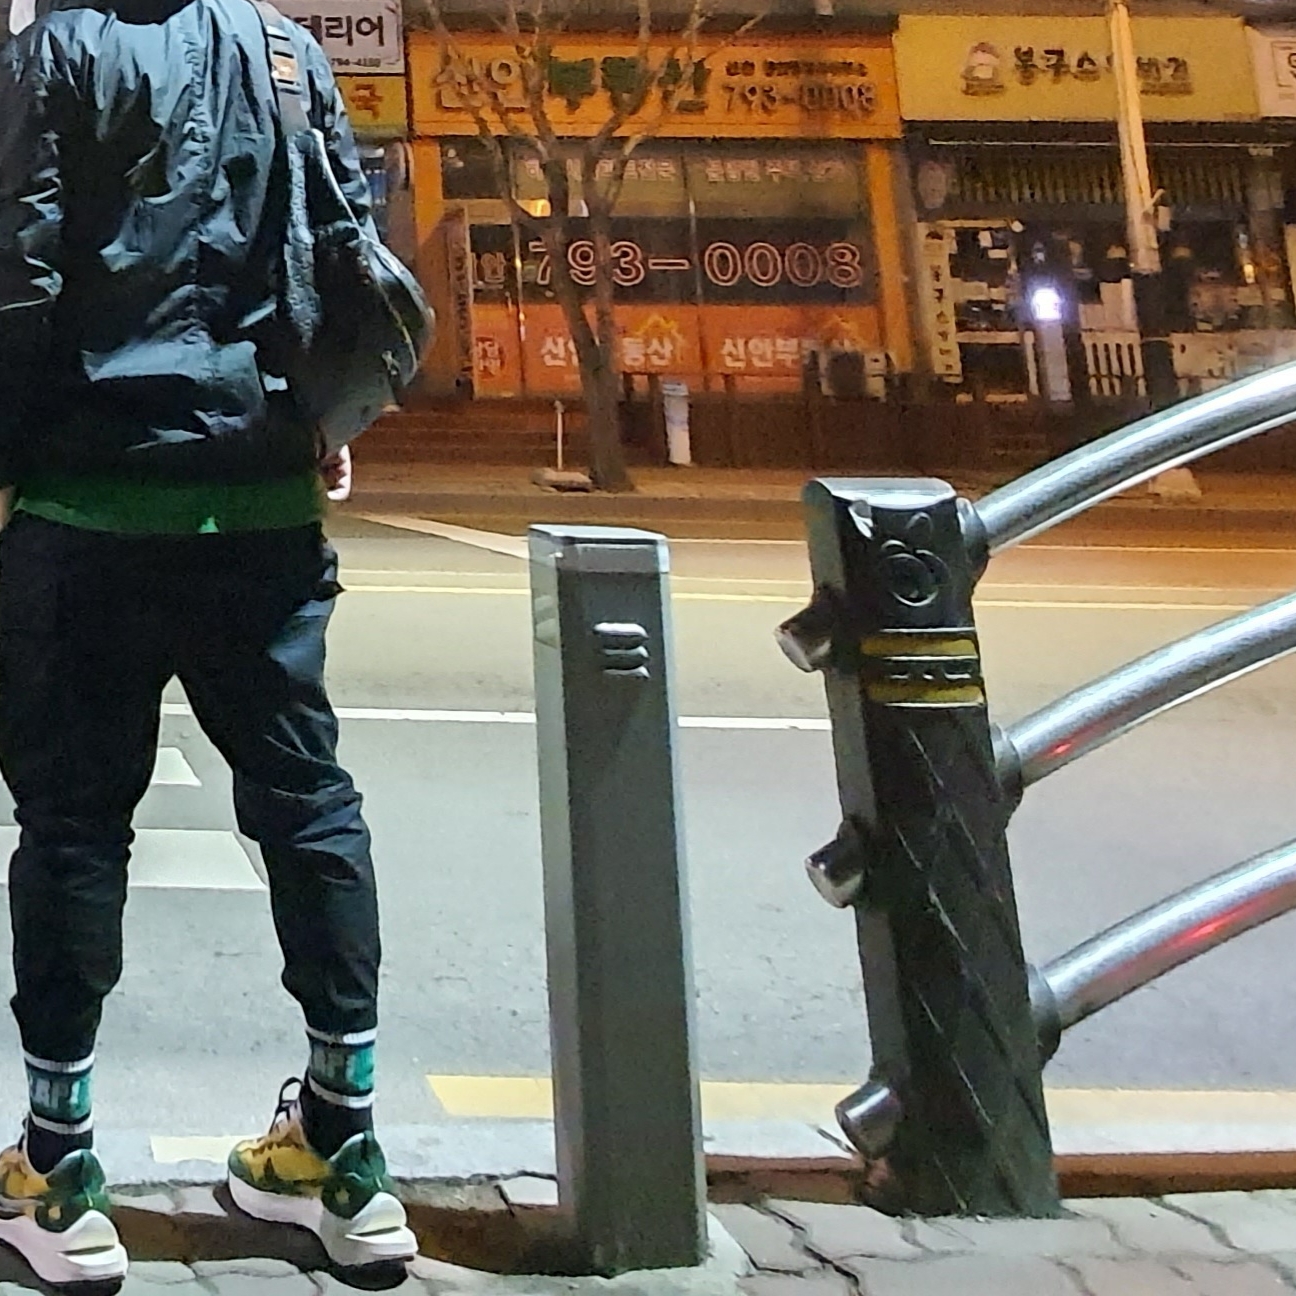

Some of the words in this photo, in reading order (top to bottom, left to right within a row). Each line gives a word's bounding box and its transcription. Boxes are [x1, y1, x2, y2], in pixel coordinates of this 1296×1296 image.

[293, 14, 385, 47] 테리어
[1013, 45, 1191, 87] 봉구스버거
[540, 335, 675, 369] 신동산
